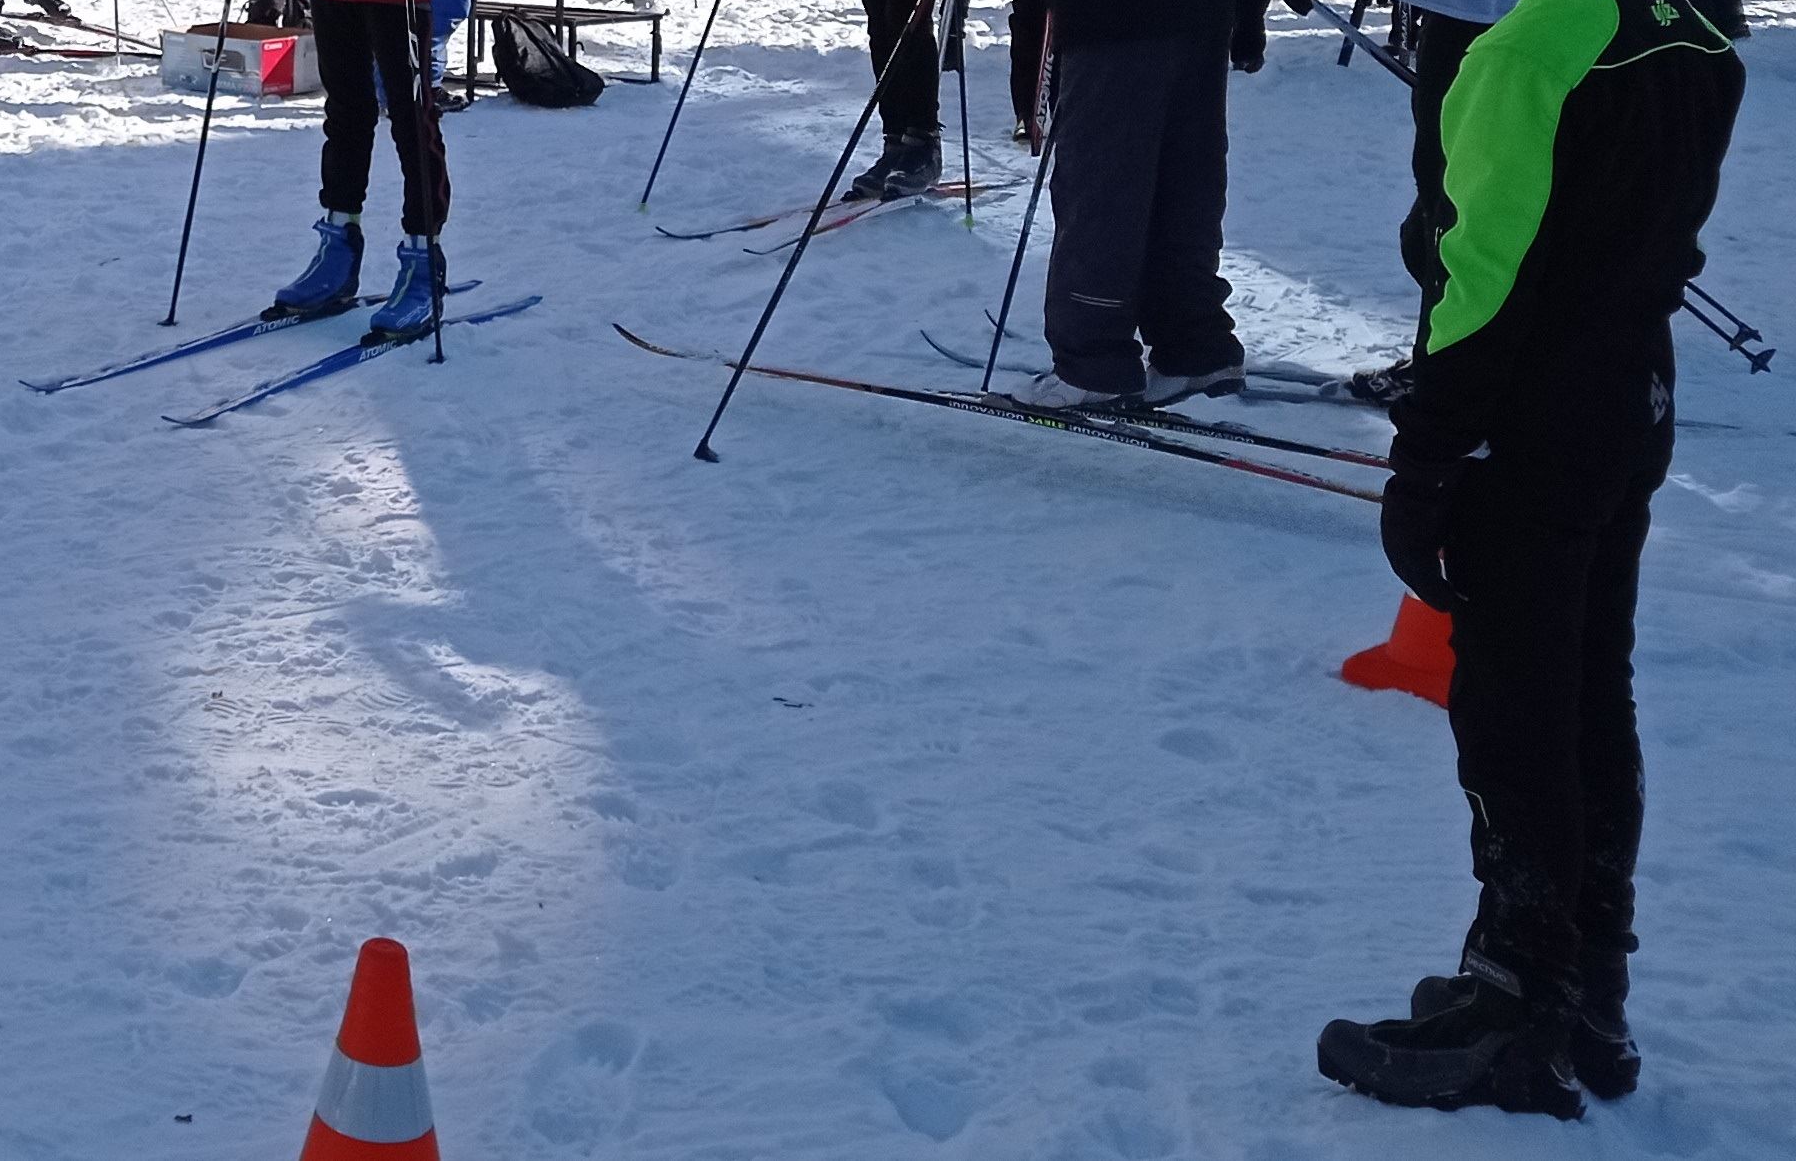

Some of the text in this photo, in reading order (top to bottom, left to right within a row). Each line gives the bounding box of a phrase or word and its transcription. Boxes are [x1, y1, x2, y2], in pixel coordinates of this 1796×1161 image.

[1036, 47, 1054, 132] ATOMIC
[253, 314, 301, 336] ATOMIC
[358, 339, 398, 362] ATOMIC
